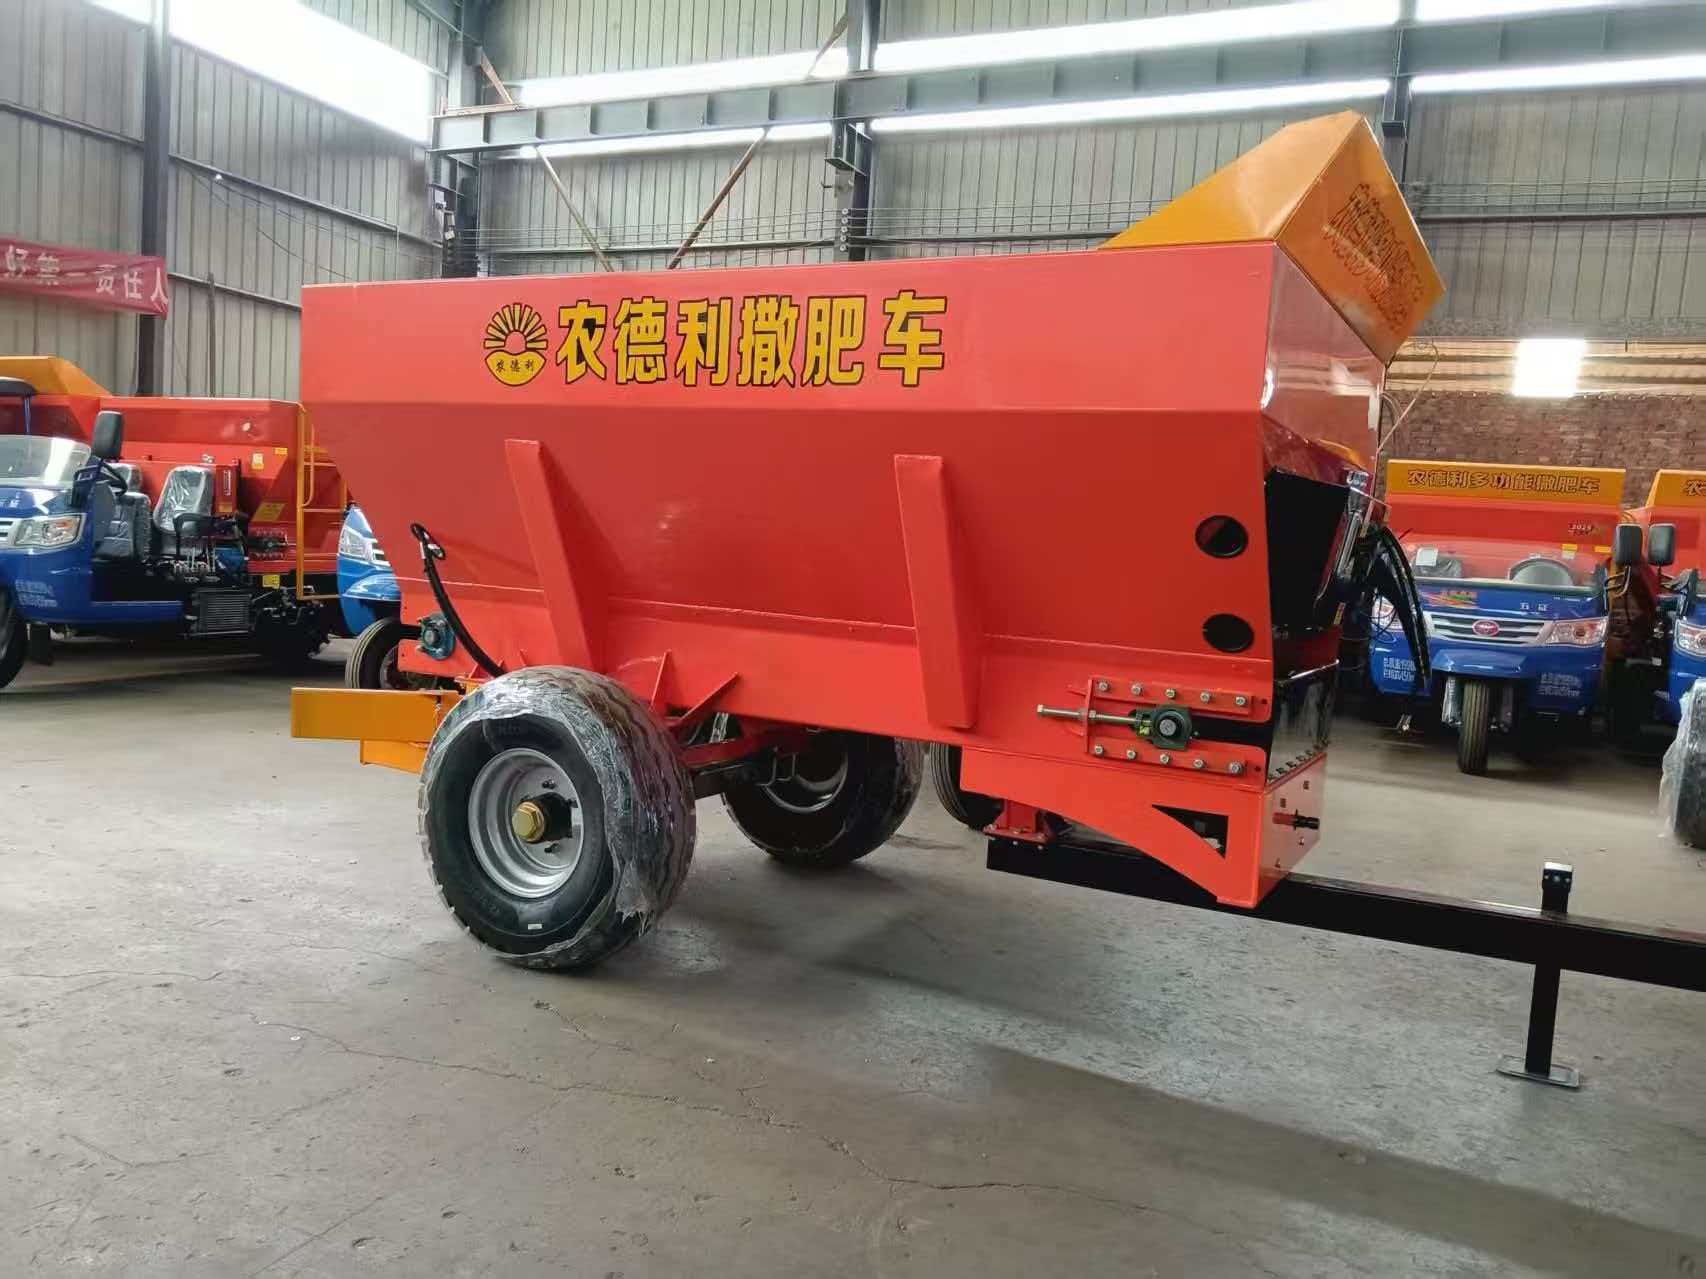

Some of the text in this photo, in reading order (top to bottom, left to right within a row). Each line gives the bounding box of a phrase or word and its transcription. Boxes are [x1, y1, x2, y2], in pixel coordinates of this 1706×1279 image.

[555, 289, 948, 387] 农德利撒肥车
